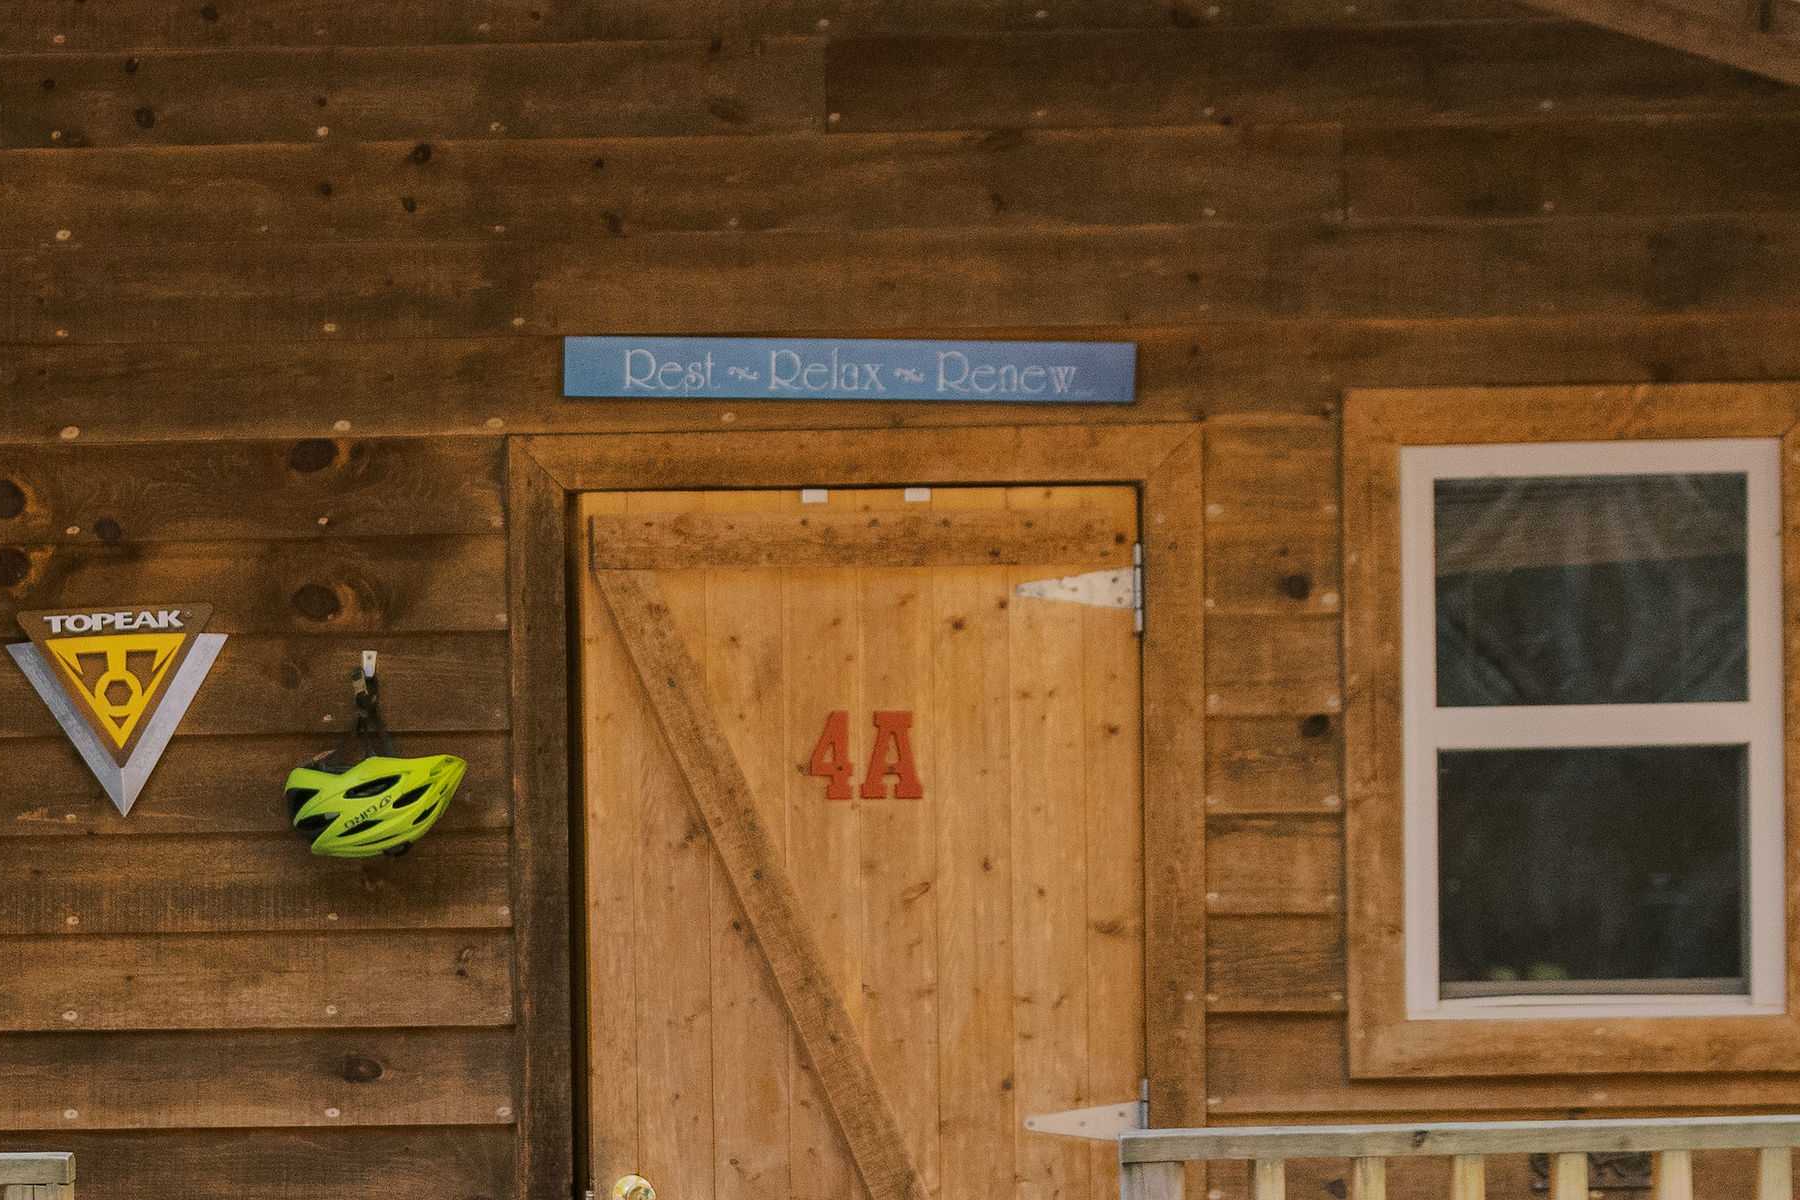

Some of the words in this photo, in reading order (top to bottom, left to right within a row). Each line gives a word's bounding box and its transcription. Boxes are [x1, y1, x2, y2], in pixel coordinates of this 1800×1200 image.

[623, 348, 718, 397] Rest
[767, 347, 887, 391] Relax
[43, 609, 185, 635] TOPEAK
[809, 709, 923, 800] 4A
[344, 805, 378, 829] GIRO
